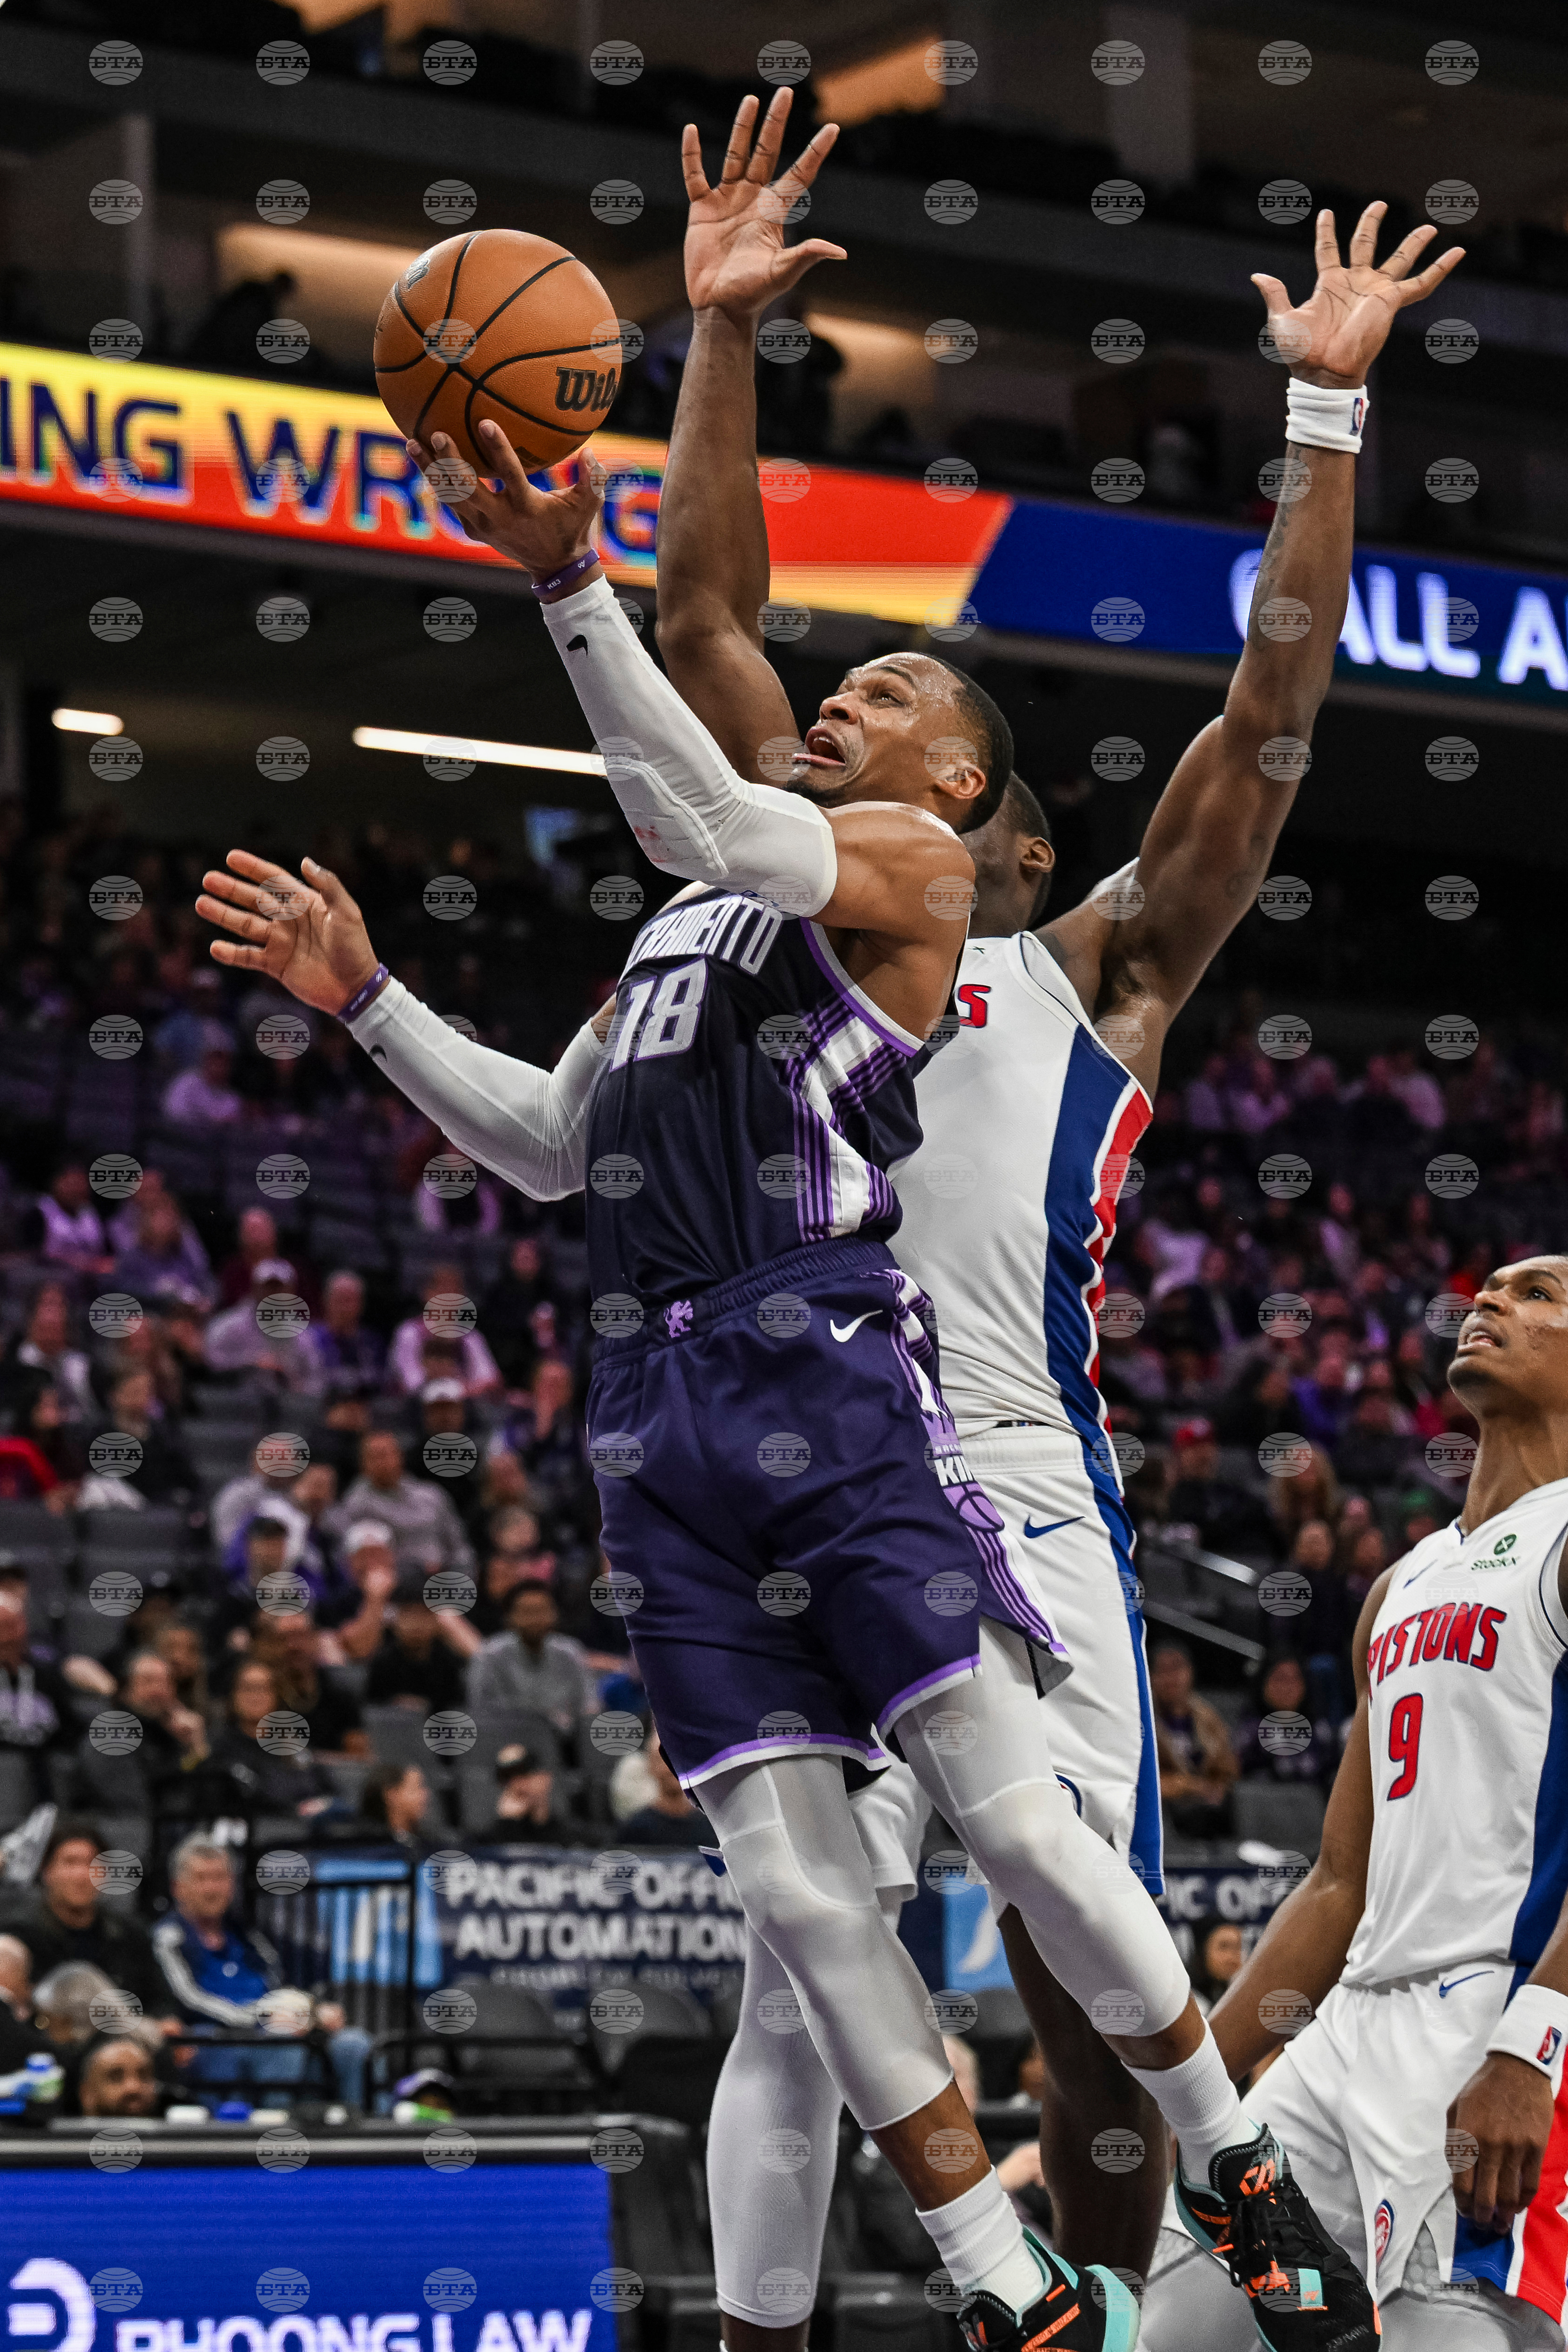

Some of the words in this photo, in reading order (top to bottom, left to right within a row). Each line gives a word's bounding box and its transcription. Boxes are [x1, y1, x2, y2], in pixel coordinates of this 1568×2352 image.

[555, 366, 617, 412] Wil
[224, 408, 657, 570] WRG
[610, 958, 707, 1072] 18
[1368, 1602, 1508, 1698] PISTONS
[1387, 1692, 1423, 1799] 9
